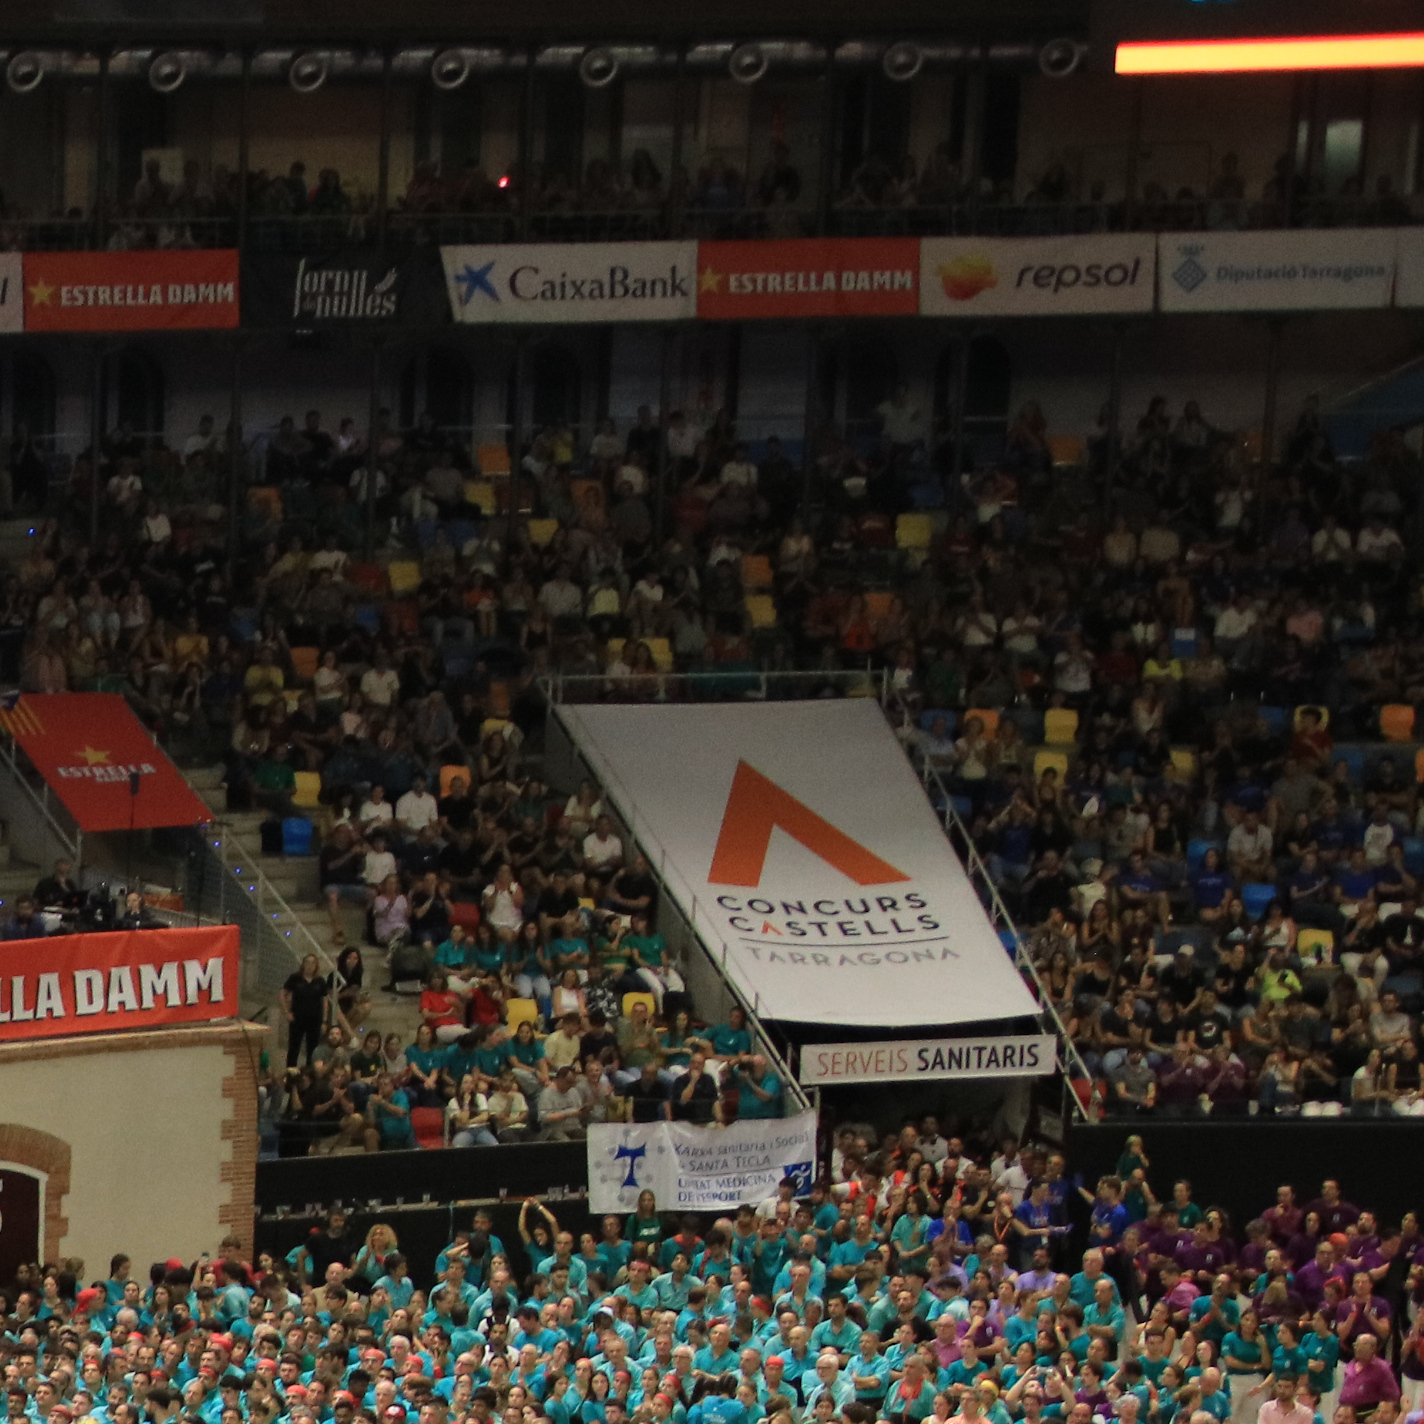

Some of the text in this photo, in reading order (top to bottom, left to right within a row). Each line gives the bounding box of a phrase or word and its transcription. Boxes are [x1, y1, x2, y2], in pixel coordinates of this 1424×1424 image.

[509, 265, 689, 301] CaixaBank
[728, 269, 912, 294] ESTRELLA DAMM
[1015, 257, 1141, 293] repsol
[1216, 262, 1386, 284] Diputació Tarragona
[61, 282, 234, 307] ESTRELLA DAMM
[717, 893, 928, 917] CONCURS
[729, 914, 940, 937] CASTELLS
[746, 945, 961, 967] TARRAGONA
[74, 957, 225, 1016] DAMM
[816, 1043, 1040, 1077] SERVEIS SANITARIS
[688, 1155, 772, 1172] SANTA TECLA
